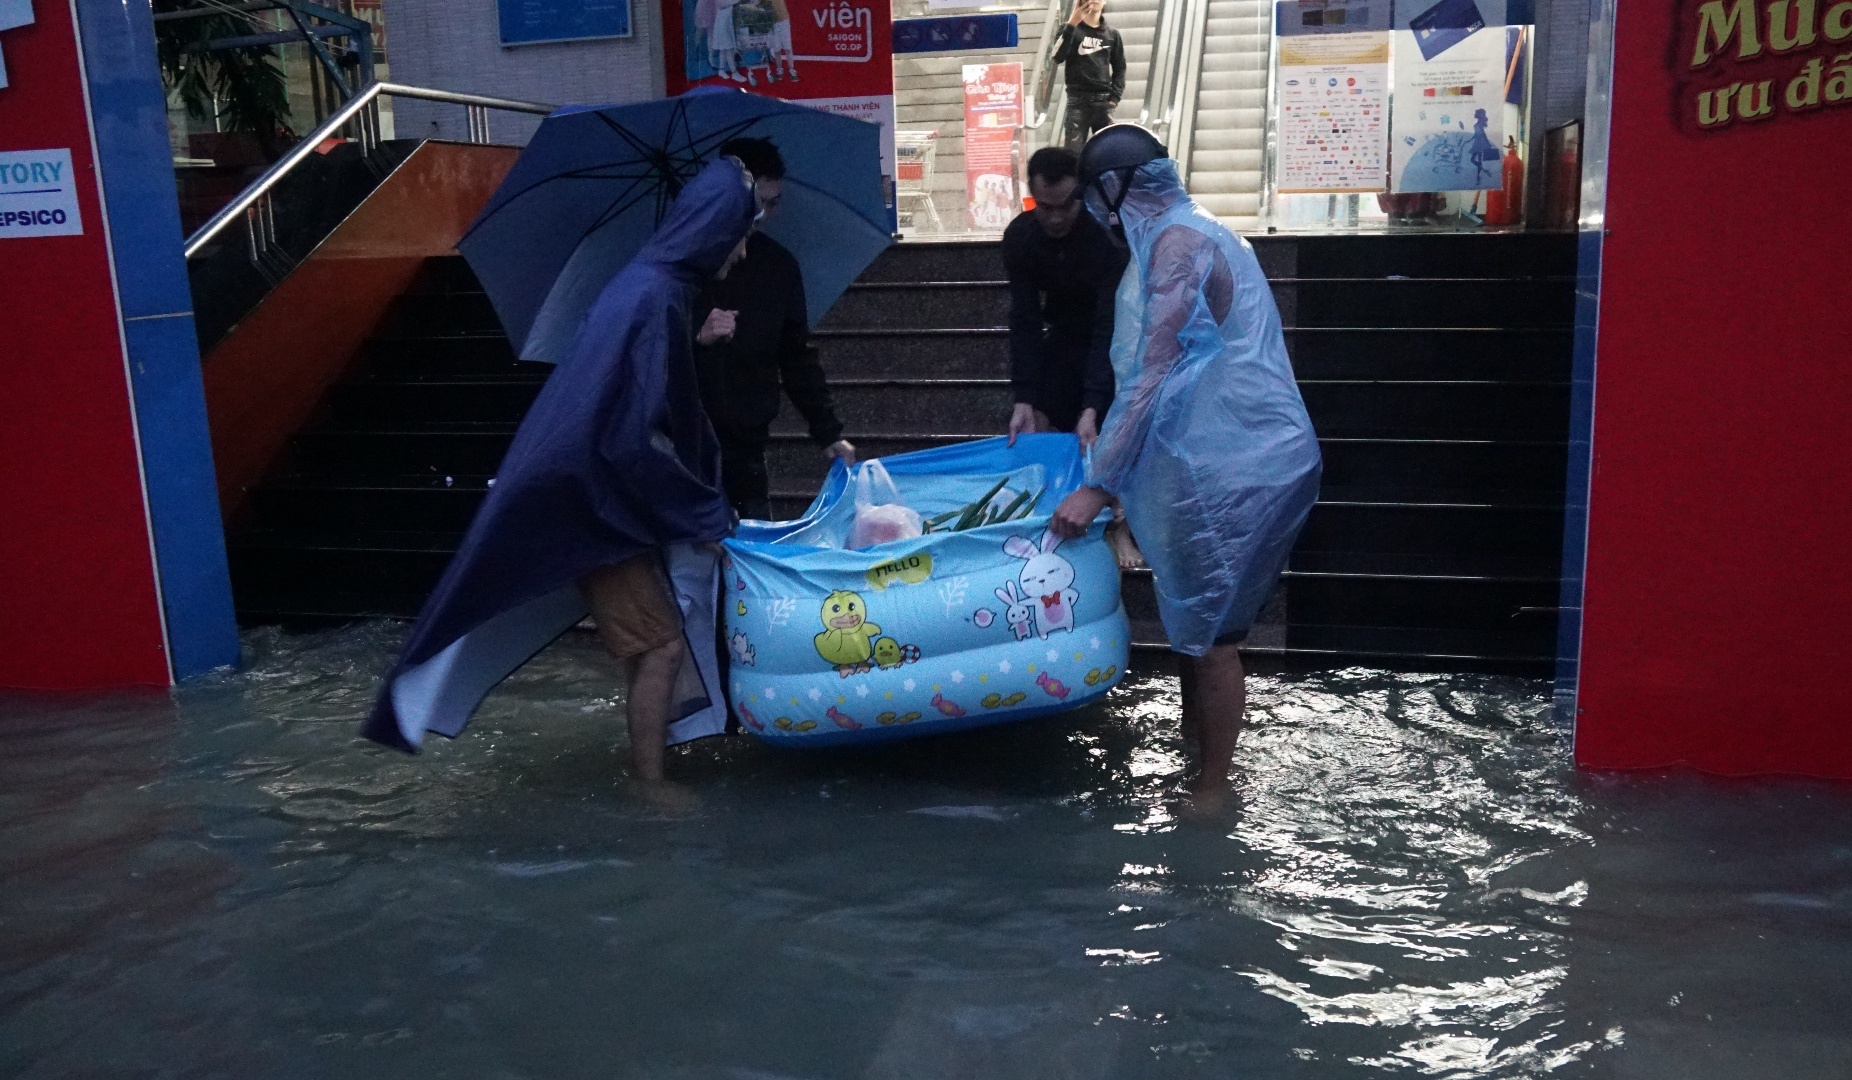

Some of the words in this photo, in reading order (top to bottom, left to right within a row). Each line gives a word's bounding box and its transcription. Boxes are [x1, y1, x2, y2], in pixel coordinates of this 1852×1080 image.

[812, 1, 872, 28] viên
[828, 33, 862, 41] SAIGON
[835, 43, 862, 51] CO.OP
[832, 102, 860, 112] THÀNH
[862, 101, 880, 110] VIÊN
[1698, 80, 1773, 125] ưu
[0, 161, 63, 184] TORY
